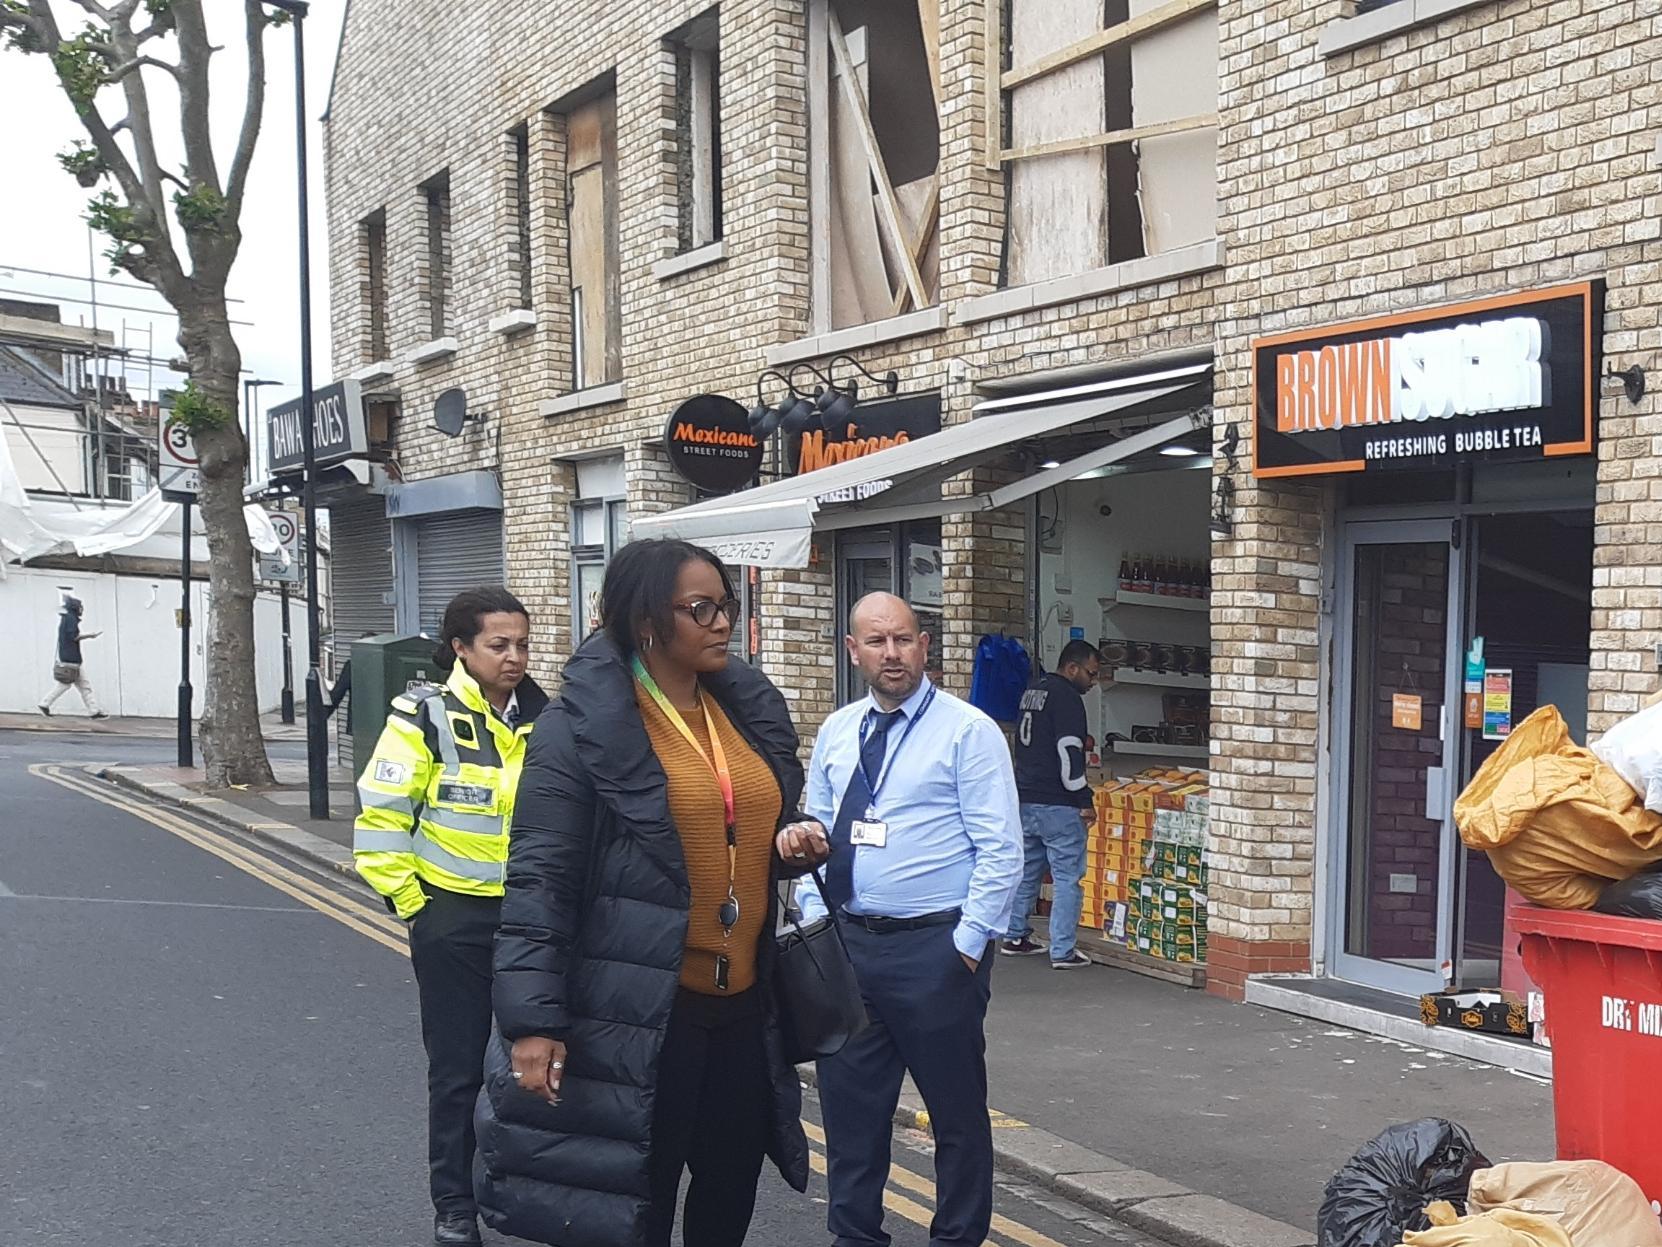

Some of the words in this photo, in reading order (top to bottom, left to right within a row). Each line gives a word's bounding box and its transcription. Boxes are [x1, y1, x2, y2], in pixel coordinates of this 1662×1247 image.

[1276, 336, 1391, 432] BROWN
[272, 408, 304, 460] BAWA
[312, 394, 345, 449] HOES
[684, 445, 716, 458] STREET
[719, 446, 749, 458] FOODS
[1365, 435, 1447, 460] REFRESHING
[1455, 429, 1510, 452] BUBBLE
[1514, 425, 1542, 448] TEA
